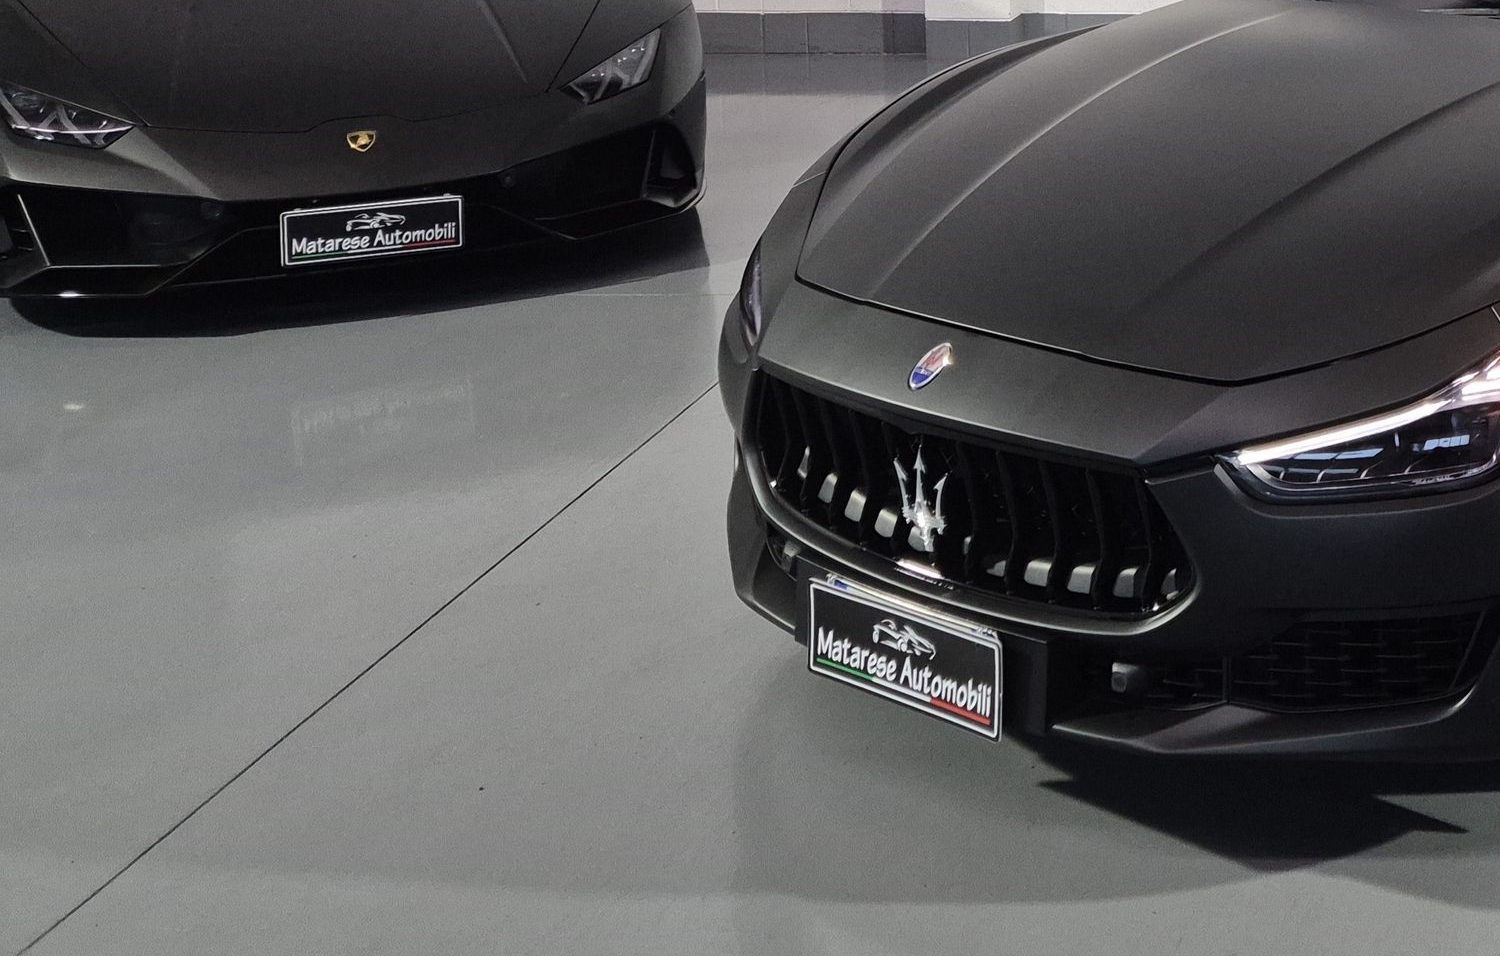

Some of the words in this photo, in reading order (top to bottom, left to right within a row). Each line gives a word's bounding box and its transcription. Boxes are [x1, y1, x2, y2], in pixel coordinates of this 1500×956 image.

[291, 234, 370, 255] Matarese
[373, 222, 456, 247] Automobili
[816, 626, 897, 681] Matarese
[900, 655, 992, 717] Automobili
